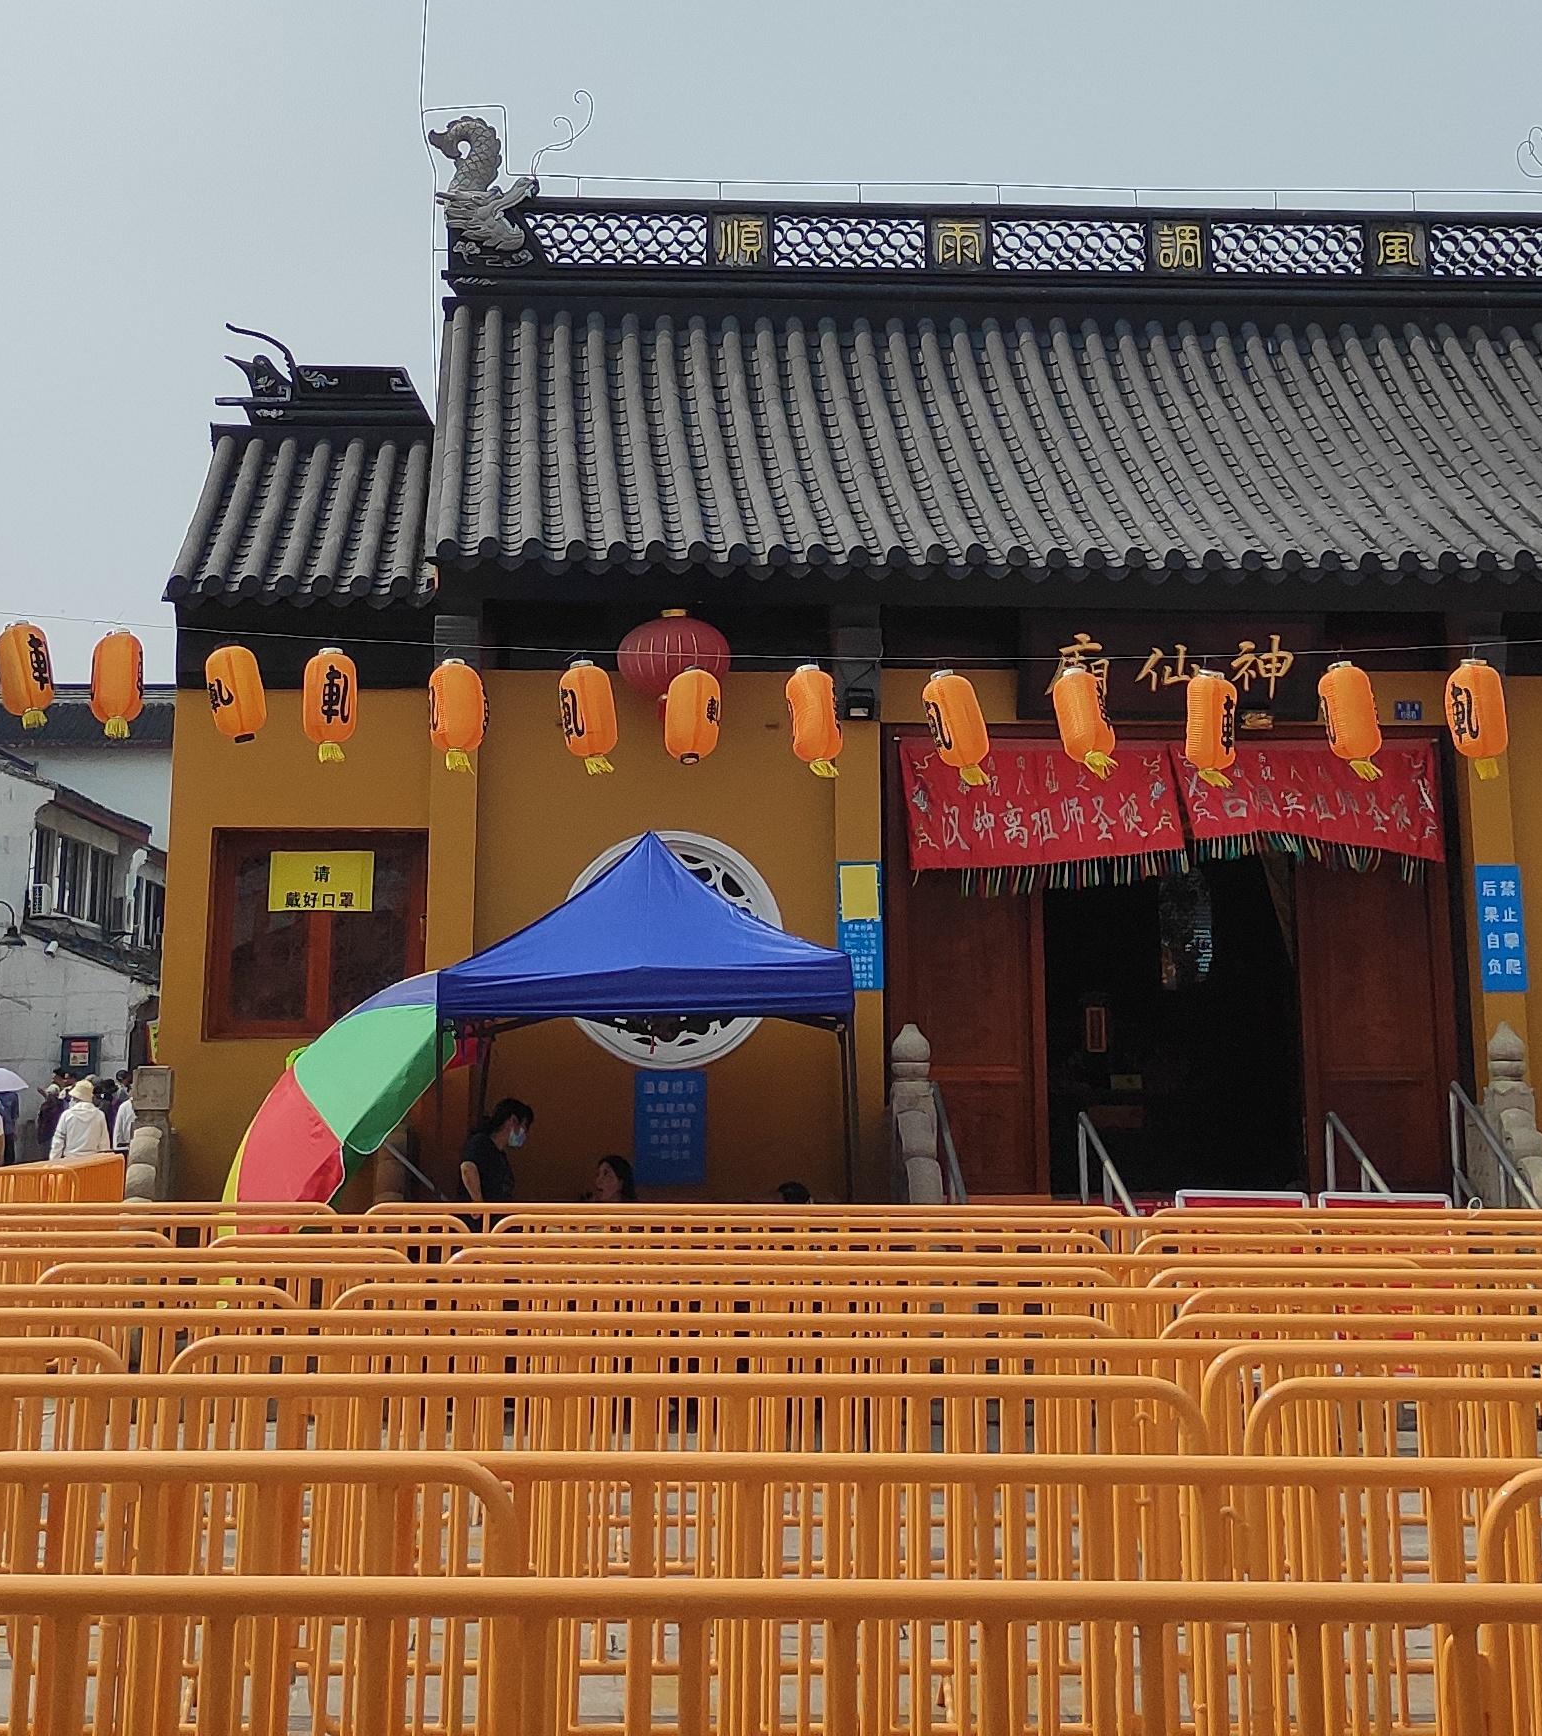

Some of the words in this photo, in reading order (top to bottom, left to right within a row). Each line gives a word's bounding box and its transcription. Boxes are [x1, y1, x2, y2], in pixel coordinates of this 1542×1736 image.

[314, 865, 331, 883] 请
[285, 891, 354, 908] 戴好口罩
[1482, 880, 1502, 976] 后果自负
